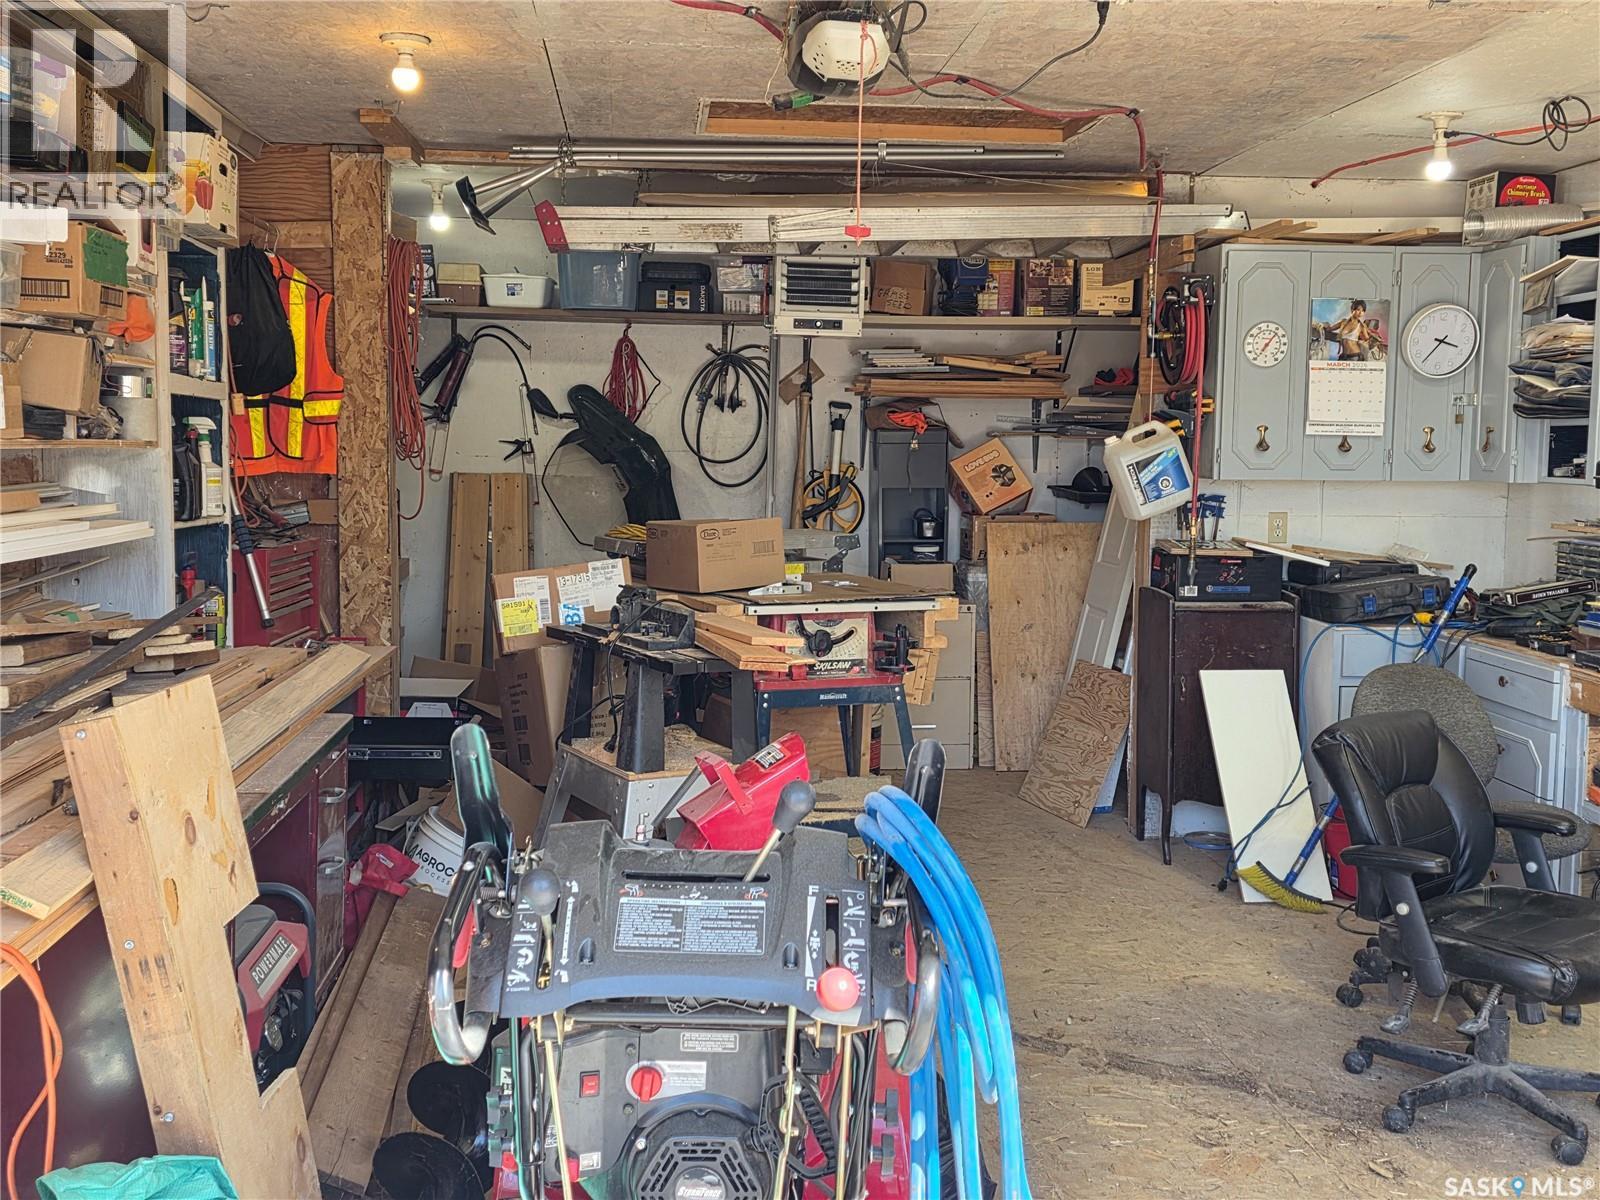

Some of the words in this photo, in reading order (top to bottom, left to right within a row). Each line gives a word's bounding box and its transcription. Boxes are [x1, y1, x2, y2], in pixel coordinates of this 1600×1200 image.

[1507, 188, 1529, 198] Chimney
[1530, 190, 1546, 198] Brush
[1547, 588, 1569, 597] SURVIVAL
[814, 661, 851, 670] SKILSAW
[415, 848, 456, 877] AGROC
[251, 936, 288, 985] POWERMATE
